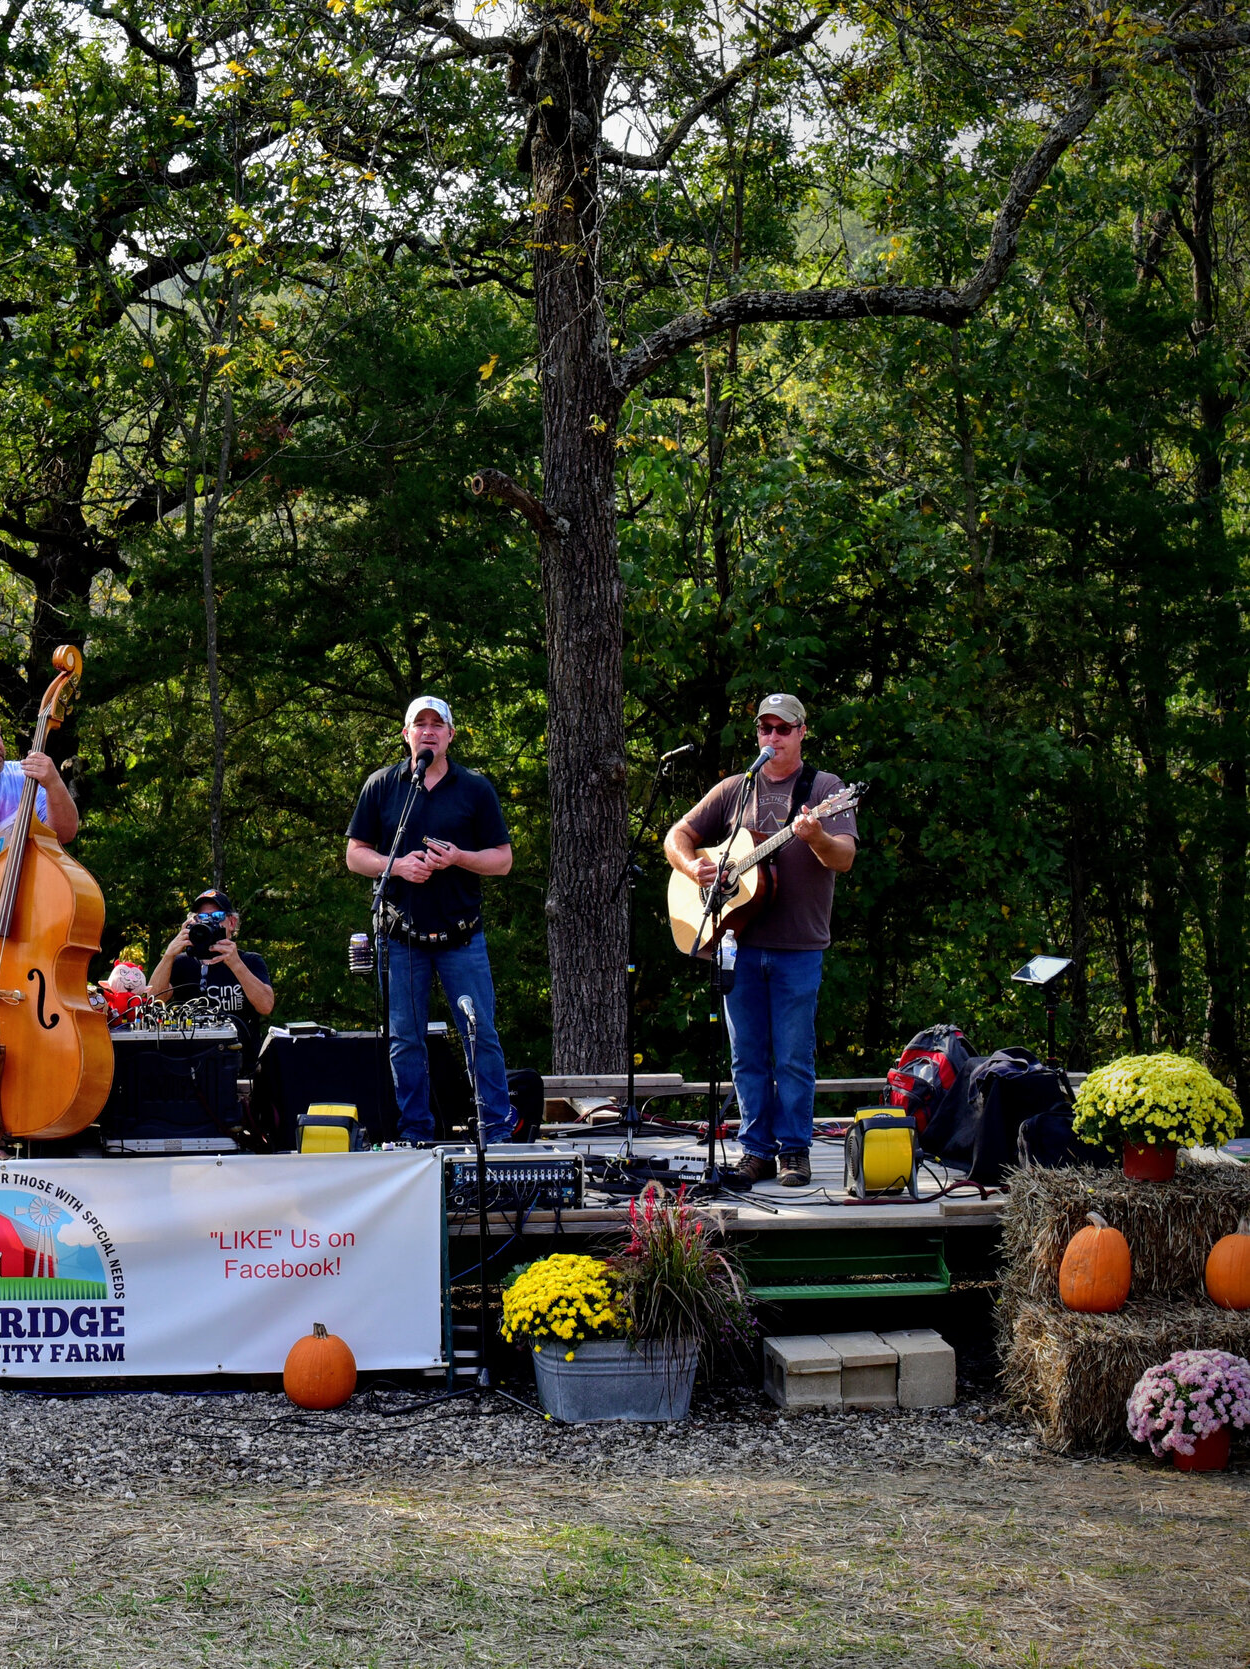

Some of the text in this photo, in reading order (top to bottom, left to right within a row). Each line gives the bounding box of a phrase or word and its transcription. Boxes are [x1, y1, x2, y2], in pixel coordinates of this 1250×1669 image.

[768, 695, 783, 705] C
[206, 984, 242, 999] Cine
[13, 1174, 54, 1194] THOSE
[55, 1187, 83, 1212] WITH
[82, 1210, 115, 1257] SPECIAL
[109, 1259, 125, 1300] NEEDS
[210, 1229, 355, 1250] "LIKE" Us on
[224, 1256, 342, 1280] Facebook!
[50, 1343, 125, 1363] FARM
